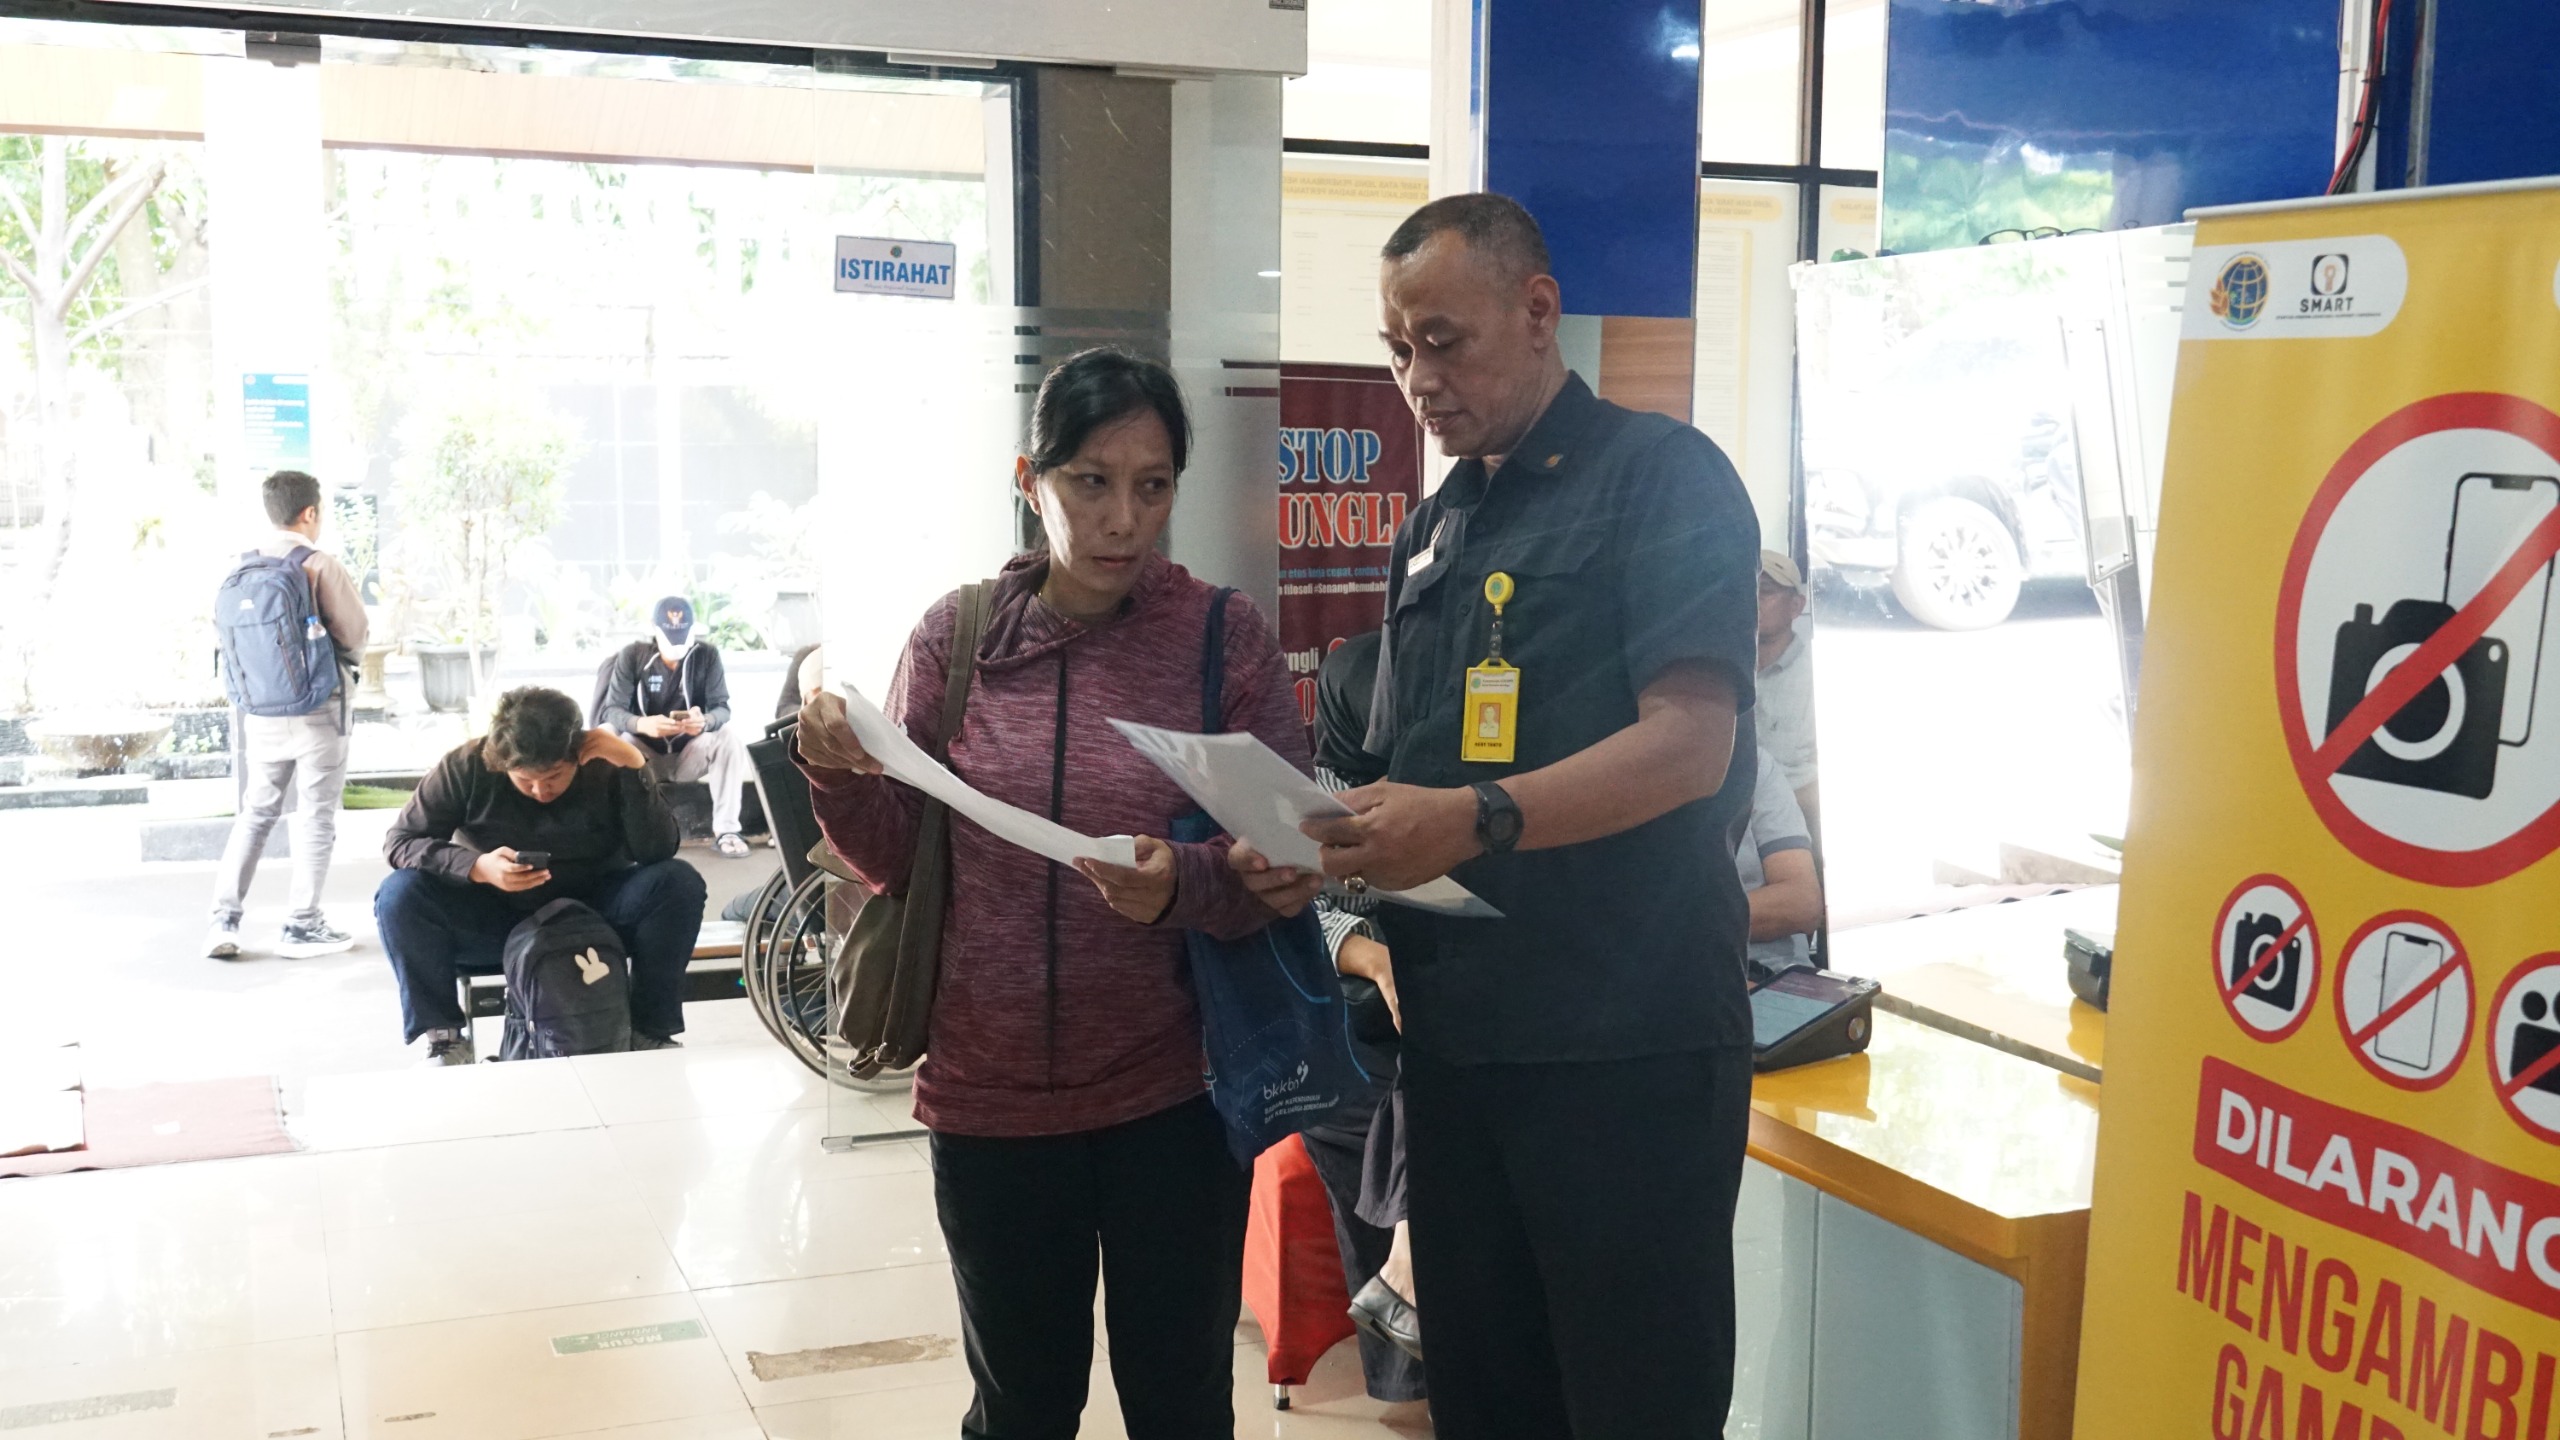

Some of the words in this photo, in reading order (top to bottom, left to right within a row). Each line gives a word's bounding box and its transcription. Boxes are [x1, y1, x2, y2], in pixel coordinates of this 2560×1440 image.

[840, 257, 951, 286] ISTIRAHAT
[2300, 297, 2354, 314] SMART
[1279, 428, 1381, 483] STOP
[1263, 1076, 1301, 1100] bkkbn
[598, 1333, 663, 1349] MASUK
[2211, 1343, 2406, 1440] GAM
